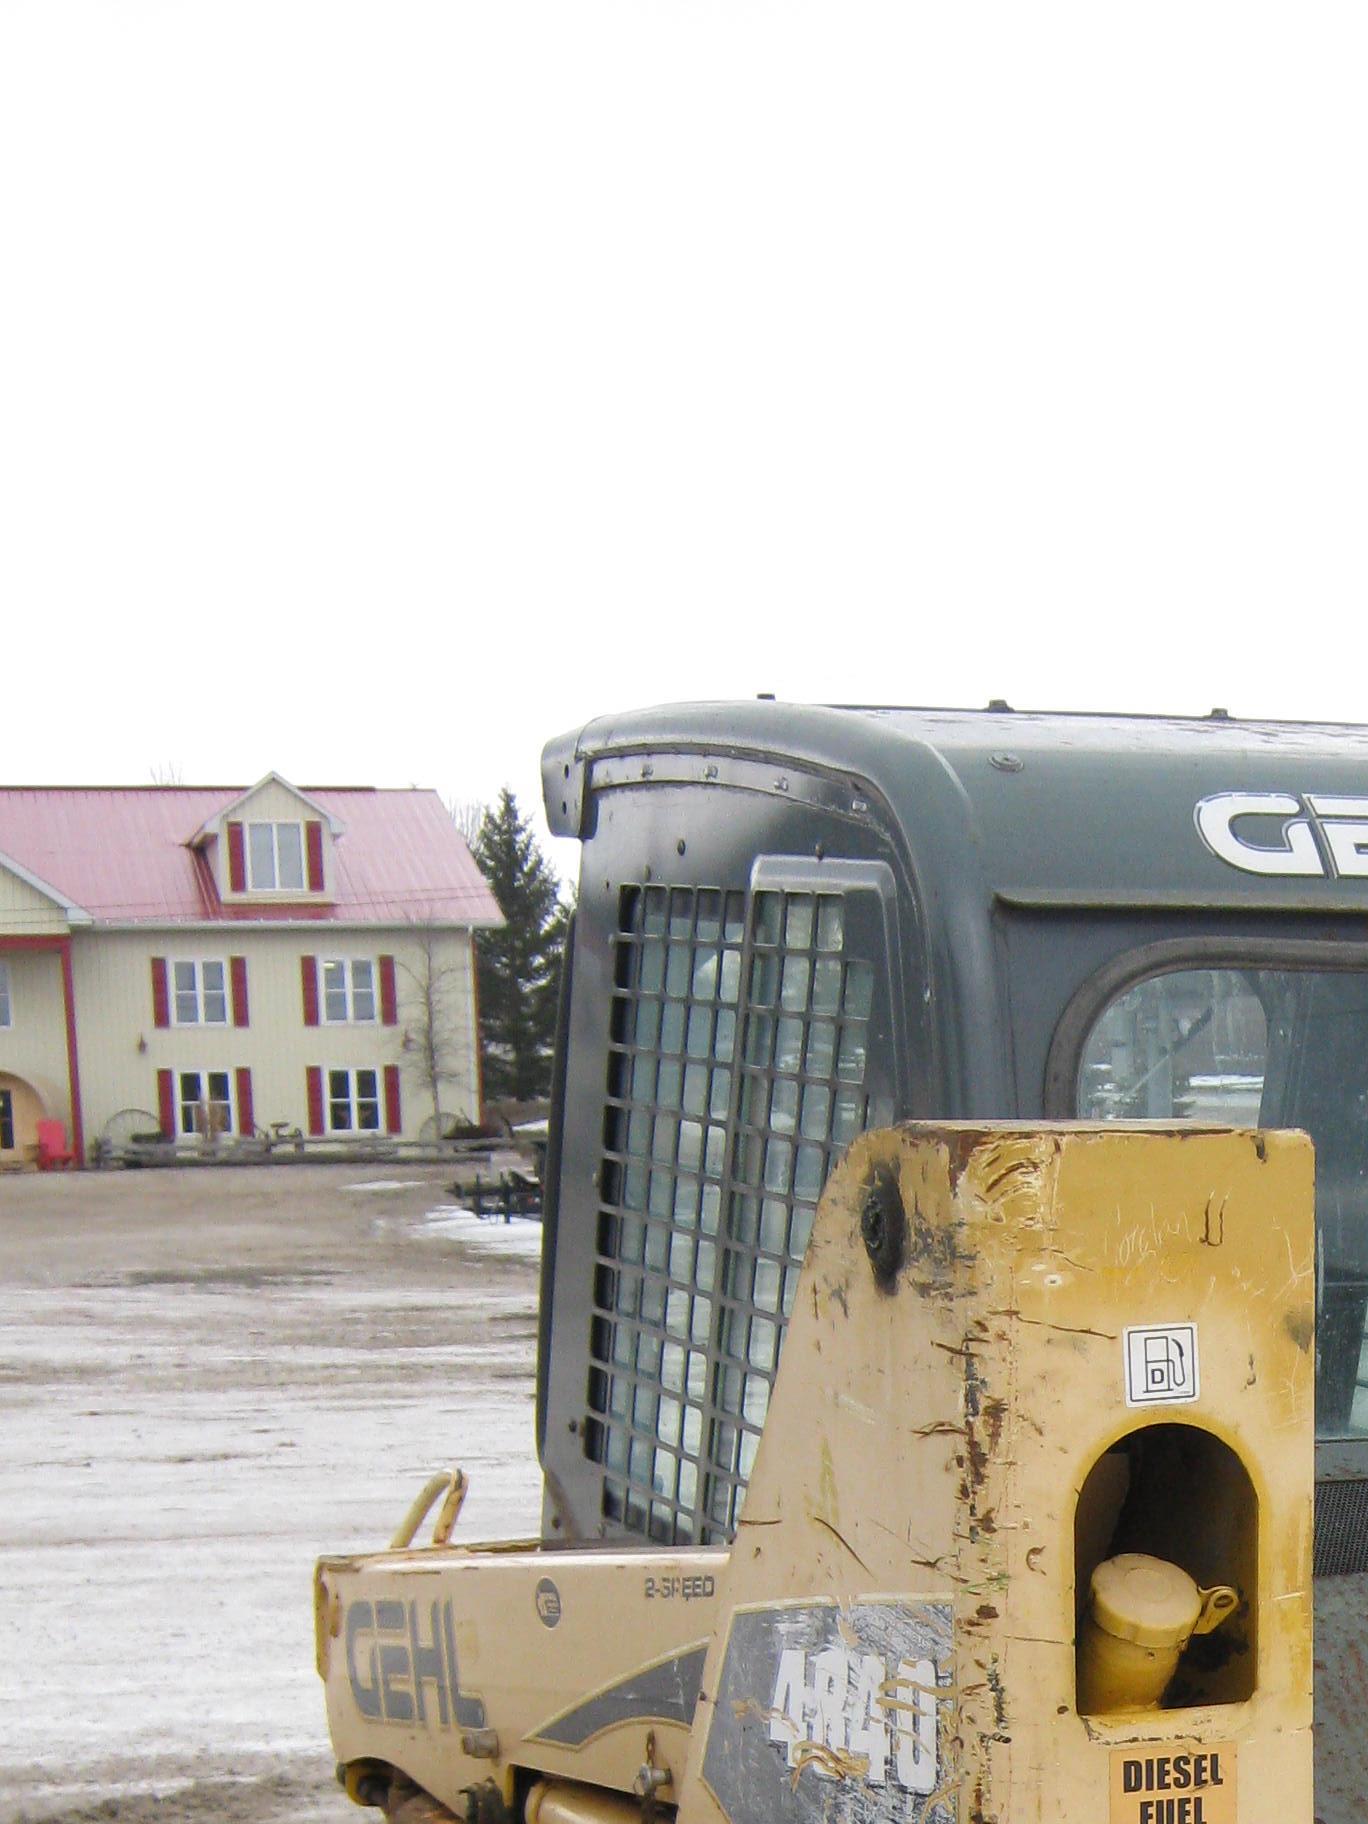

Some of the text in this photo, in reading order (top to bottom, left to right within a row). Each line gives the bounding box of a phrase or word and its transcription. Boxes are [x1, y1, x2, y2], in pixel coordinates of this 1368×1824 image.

[1151, 1368, 1164, 1384] D
[344, 1598, 489, 1729] GEHL
[1123, 1752, 1224, 1793] DIESEL
